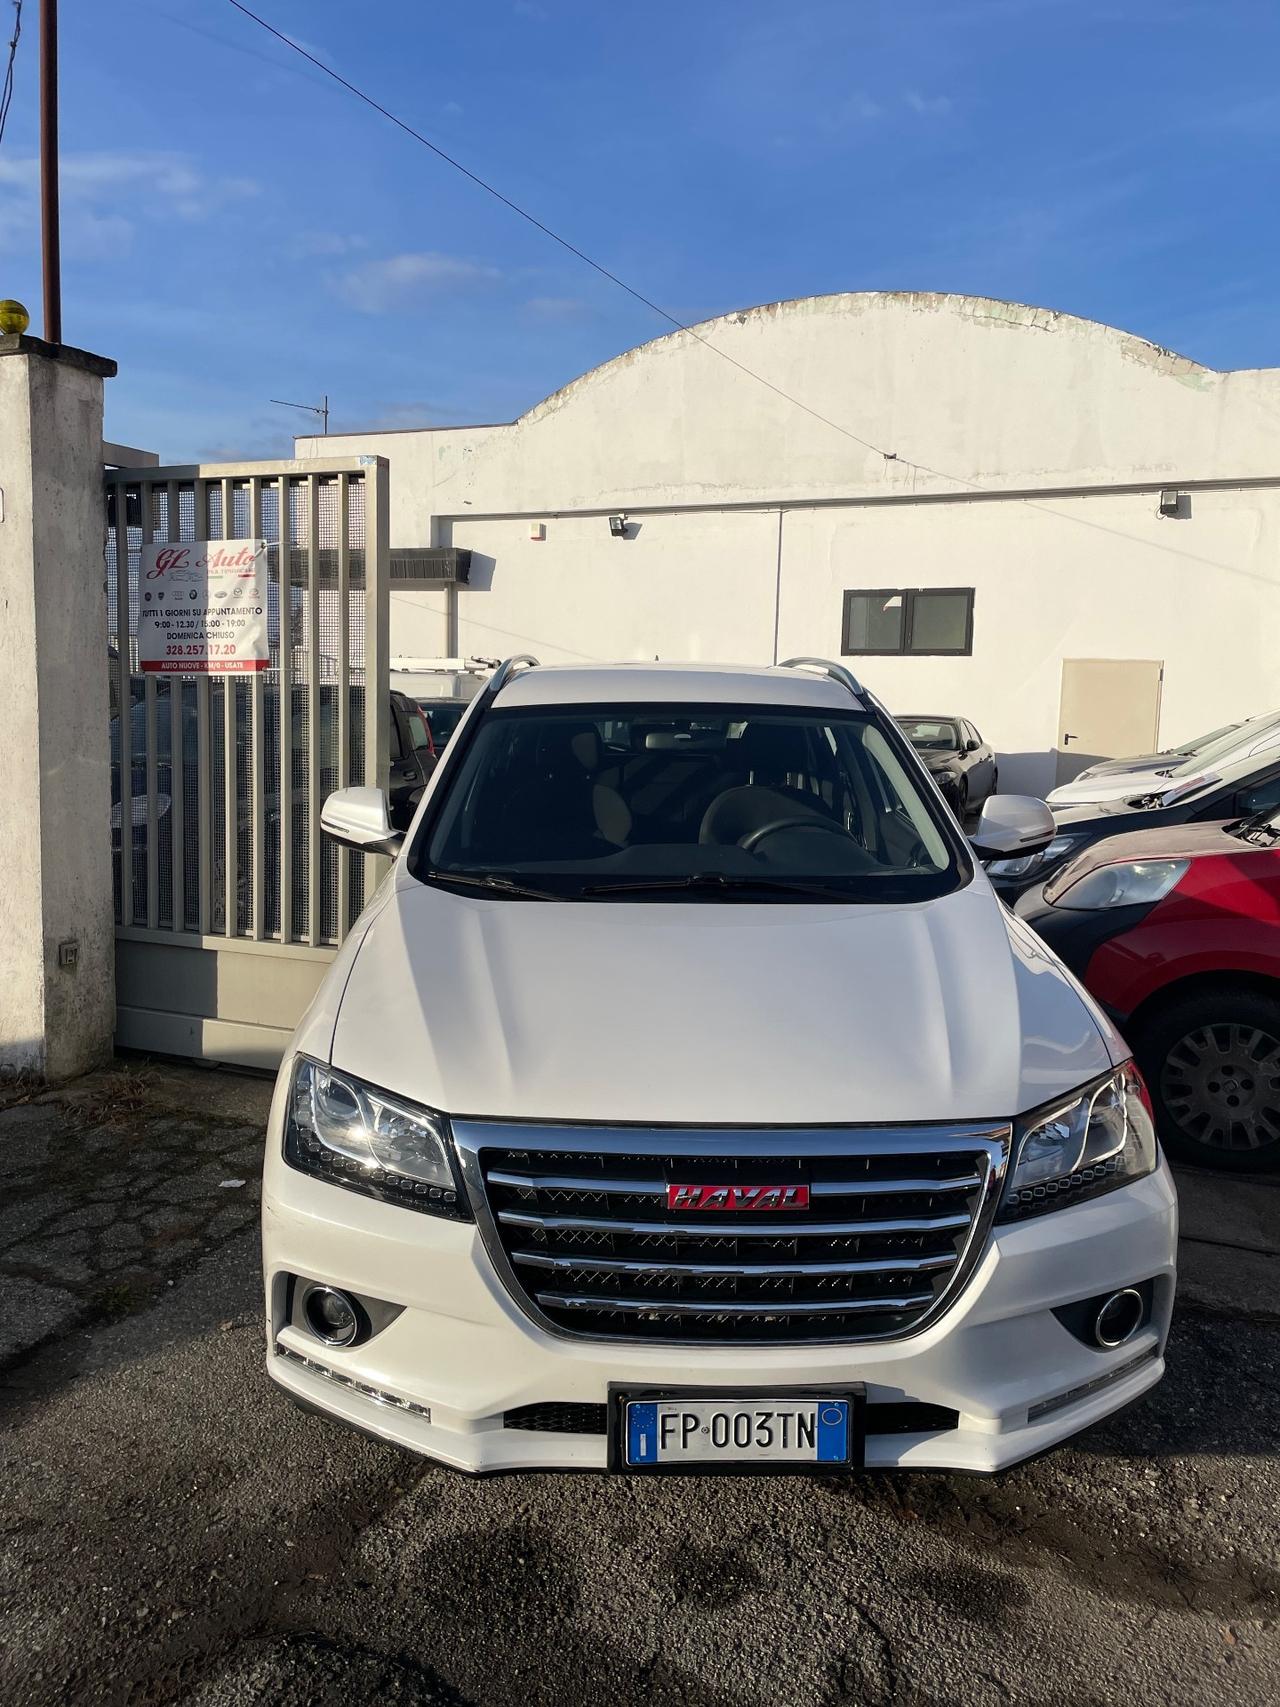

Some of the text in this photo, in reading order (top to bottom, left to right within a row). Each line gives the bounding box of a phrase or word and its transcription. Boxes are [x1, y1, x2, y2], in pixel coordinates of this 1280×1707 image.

[196, 547, 255, 568] Auto
[193, 608, 201, 616] SU
[203, 607, 262, 616] APPUNTAMENTO
[166, 645, 236, 655] 328.257.17.20
[668, 1187, 807, 1208] HAVAL
